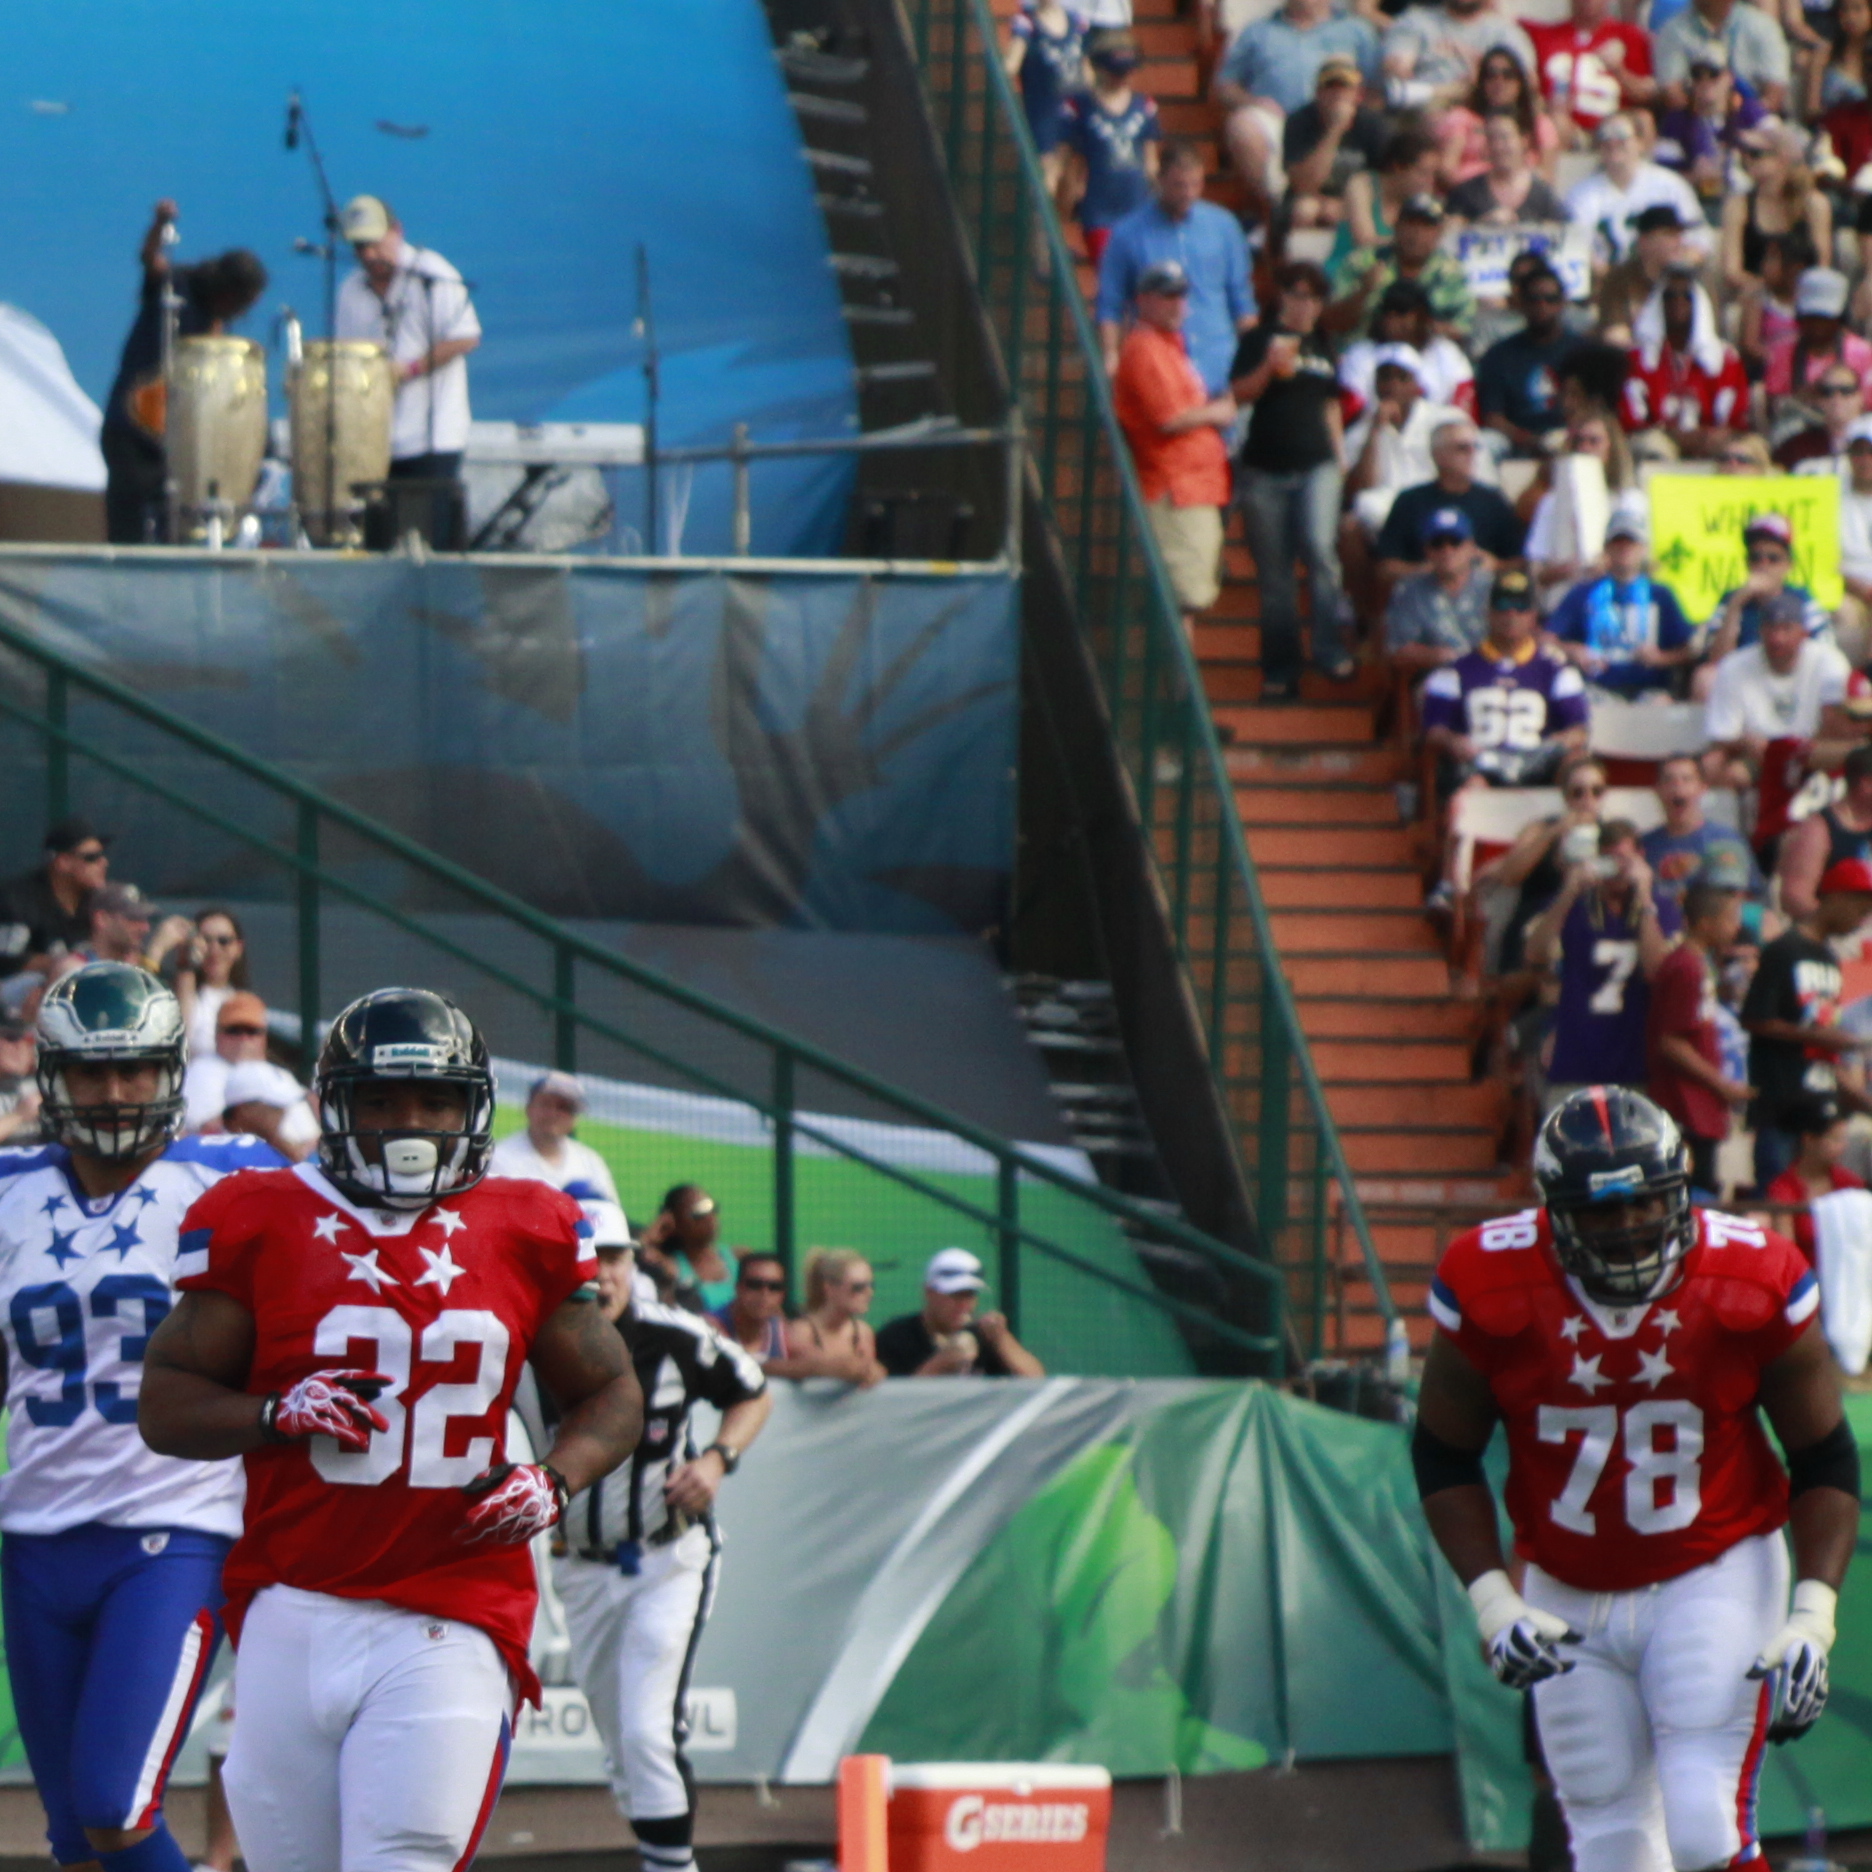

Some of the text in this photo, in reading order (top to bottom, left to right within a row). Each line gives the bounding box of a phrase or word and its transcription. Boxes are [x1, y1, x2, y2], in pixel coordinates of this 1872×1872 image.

[1589, 941, 1637, 1014] 7
[9, 1274, 171, 1428] 93
[308, 1304, 511, 1488] 32
[1537, 1398, 1705, 1536] 78
